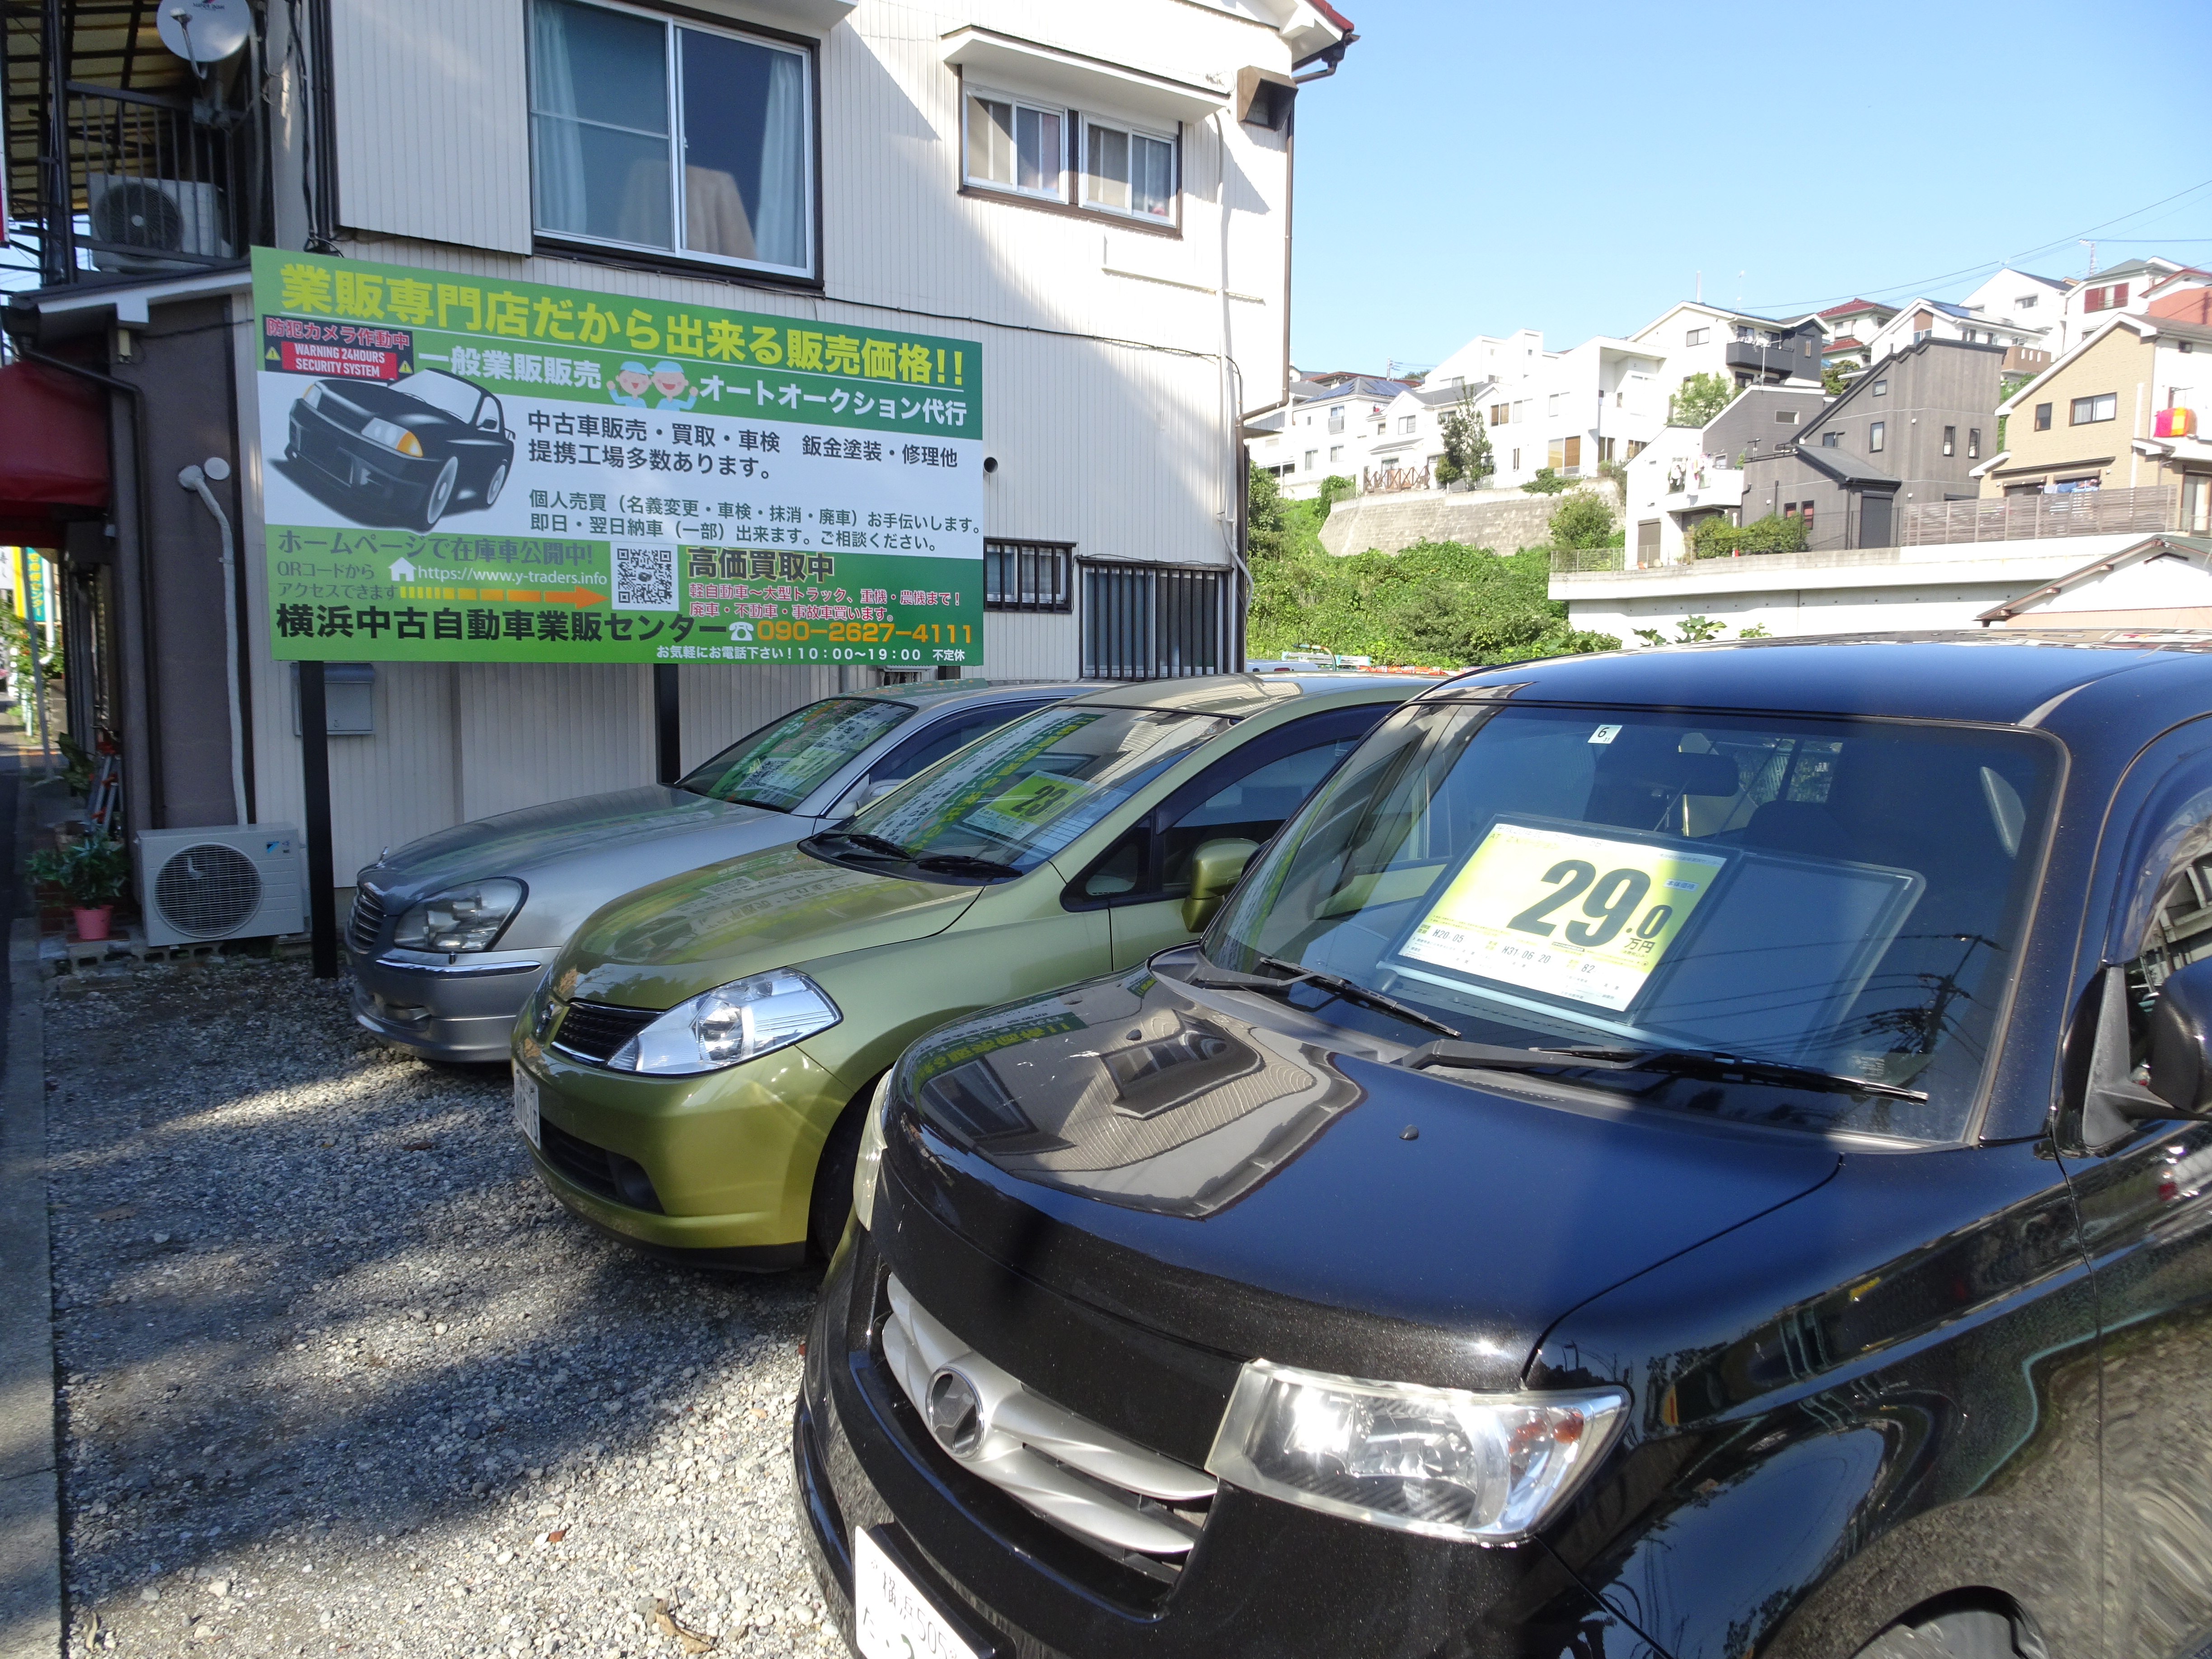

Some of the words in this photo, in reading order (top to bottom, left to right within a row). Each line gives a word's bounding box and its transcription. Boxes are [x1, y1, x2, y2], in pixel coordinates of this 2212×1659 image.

[266, 318, 409, 350] 防犯カメラ作動中
[295, 343, 339, 359] WARNING
[342, 350, 384, 363] 24HOURS
[296, 358, 341, 374] SECURITY
[343, 363, 380, 377] SYSTEM
[419, 346, 601, 389] 一般業販販売
[700, 376, 966, 426] オートオークション代行
[528, 440, 770, 481] 提携工場多数あります。
[278, 530, 591, 566] ホームページで在庫車公開中!
[278, 562, 375, 580] QRコードから
[687, 547, 834, 583] 高価買取中
[418, 566, 607, 586] https://www.y-traders.info
[278, 583, 398, 600] アクセスできます
[689, 602, 893, 621] 廃車・不動車・事故車買います。
[276, 603, 726, 643] 横浜中古自動車業販センター
[757, 620, 971, 644] 090-2627-4111
[933, 649, 965, 661] 不定休
[1598, 727, 1610, 738] 6
[1433, 929, 1448, 939] H20
[1452, 934, 1464, 943] 05
[1501, 947, 1518, 956] H31
[1521, 951, 1533, 960] 06
[1538, 954, 1551, 964] 20
[1625, 938, 1654, 954] 万円
[1581, 964, 1595, 974] 82
